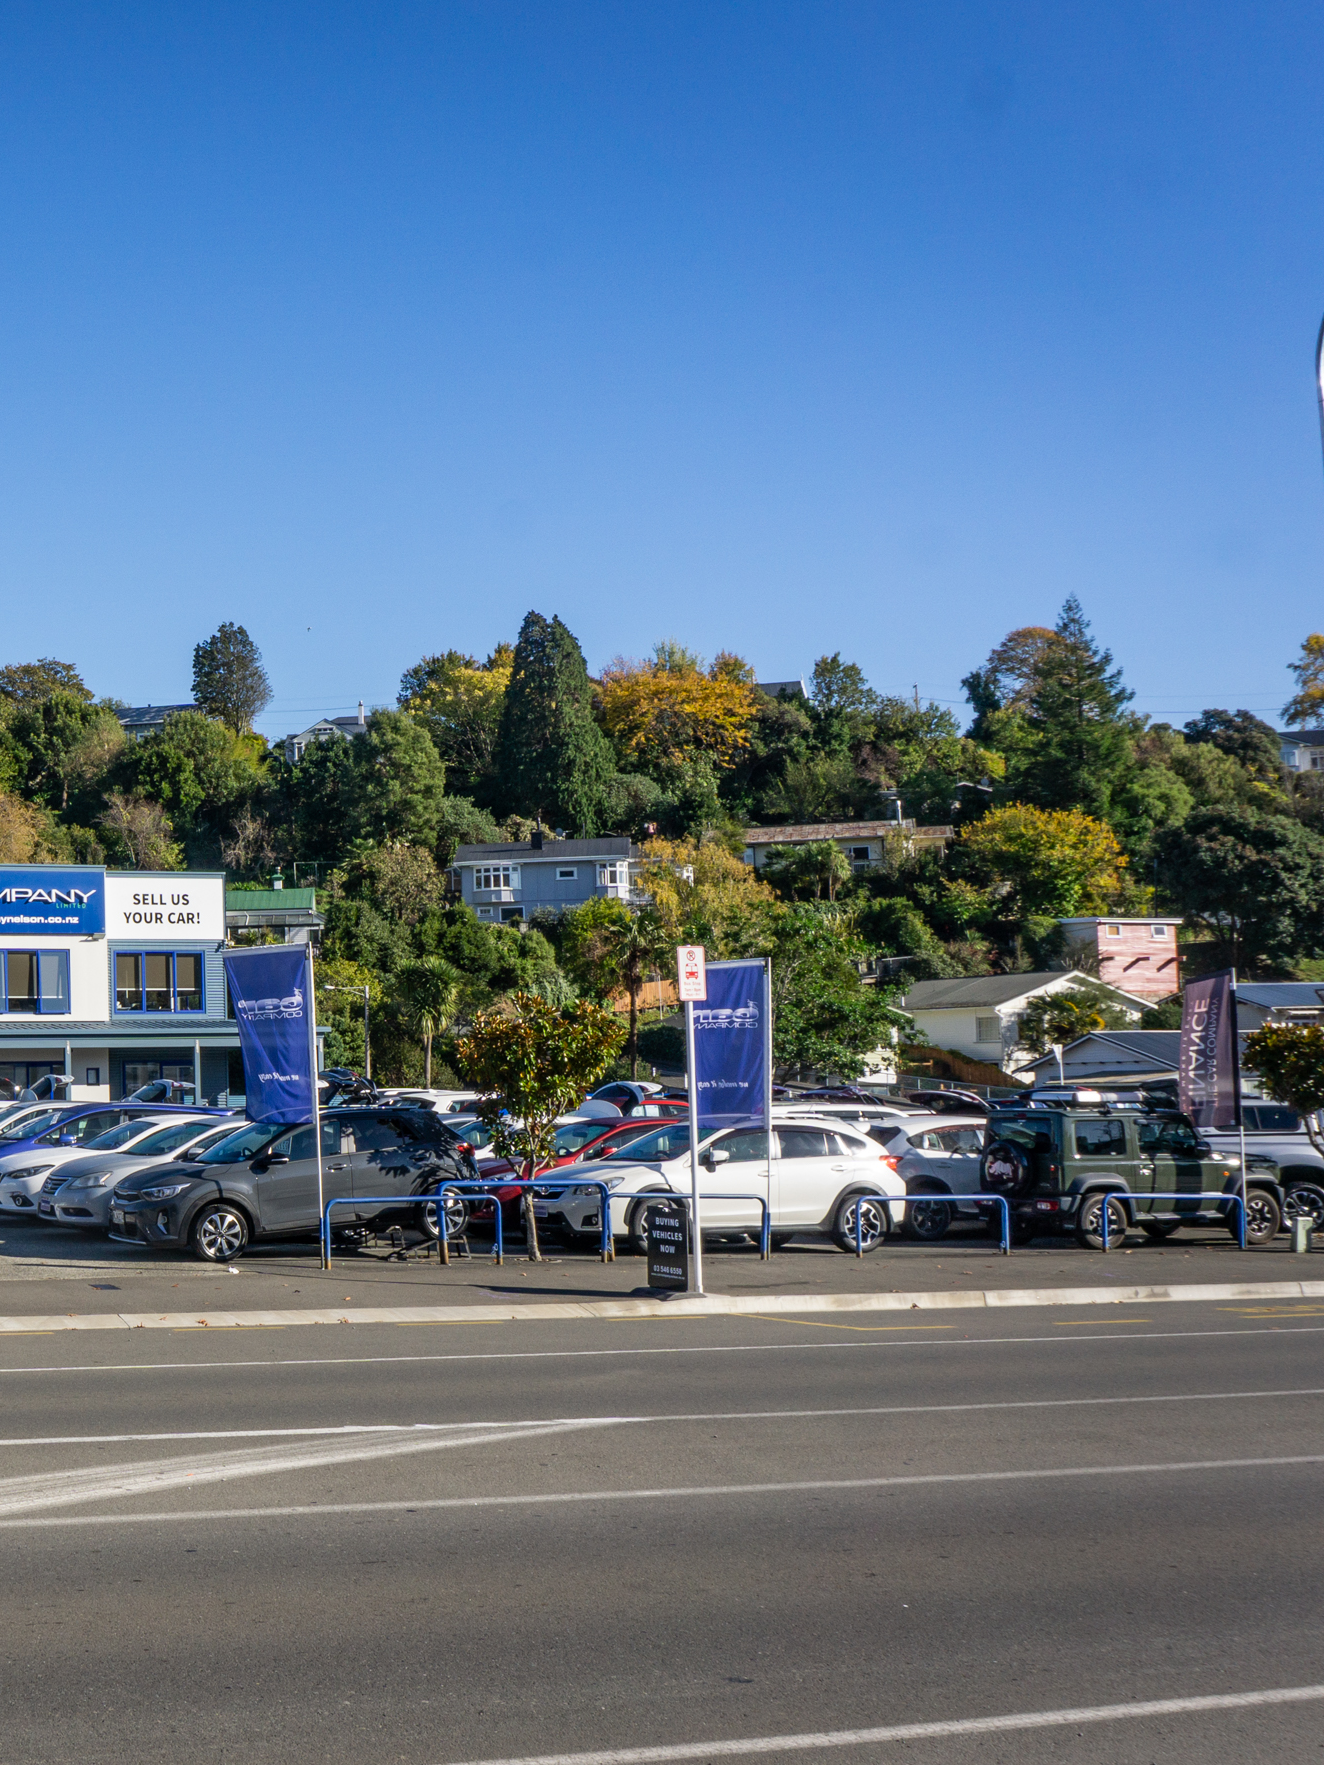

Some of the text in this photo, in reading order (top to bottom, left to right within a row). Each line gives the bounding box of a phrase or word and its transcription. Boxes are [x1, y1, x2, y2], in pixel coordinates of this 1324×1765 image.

[132, 893, 190, 905] SELL US
[123, 911, 200, 924] YOUR CAR!
[655, 1217, 679, 1227] BUYING
[652, 1230, 683, 1241] VEHICLES
[660, 1244, 675, 1254] NOW
[660, 1266, 670, 1274] 546
[670, 1267, 682, 1275] 6550
